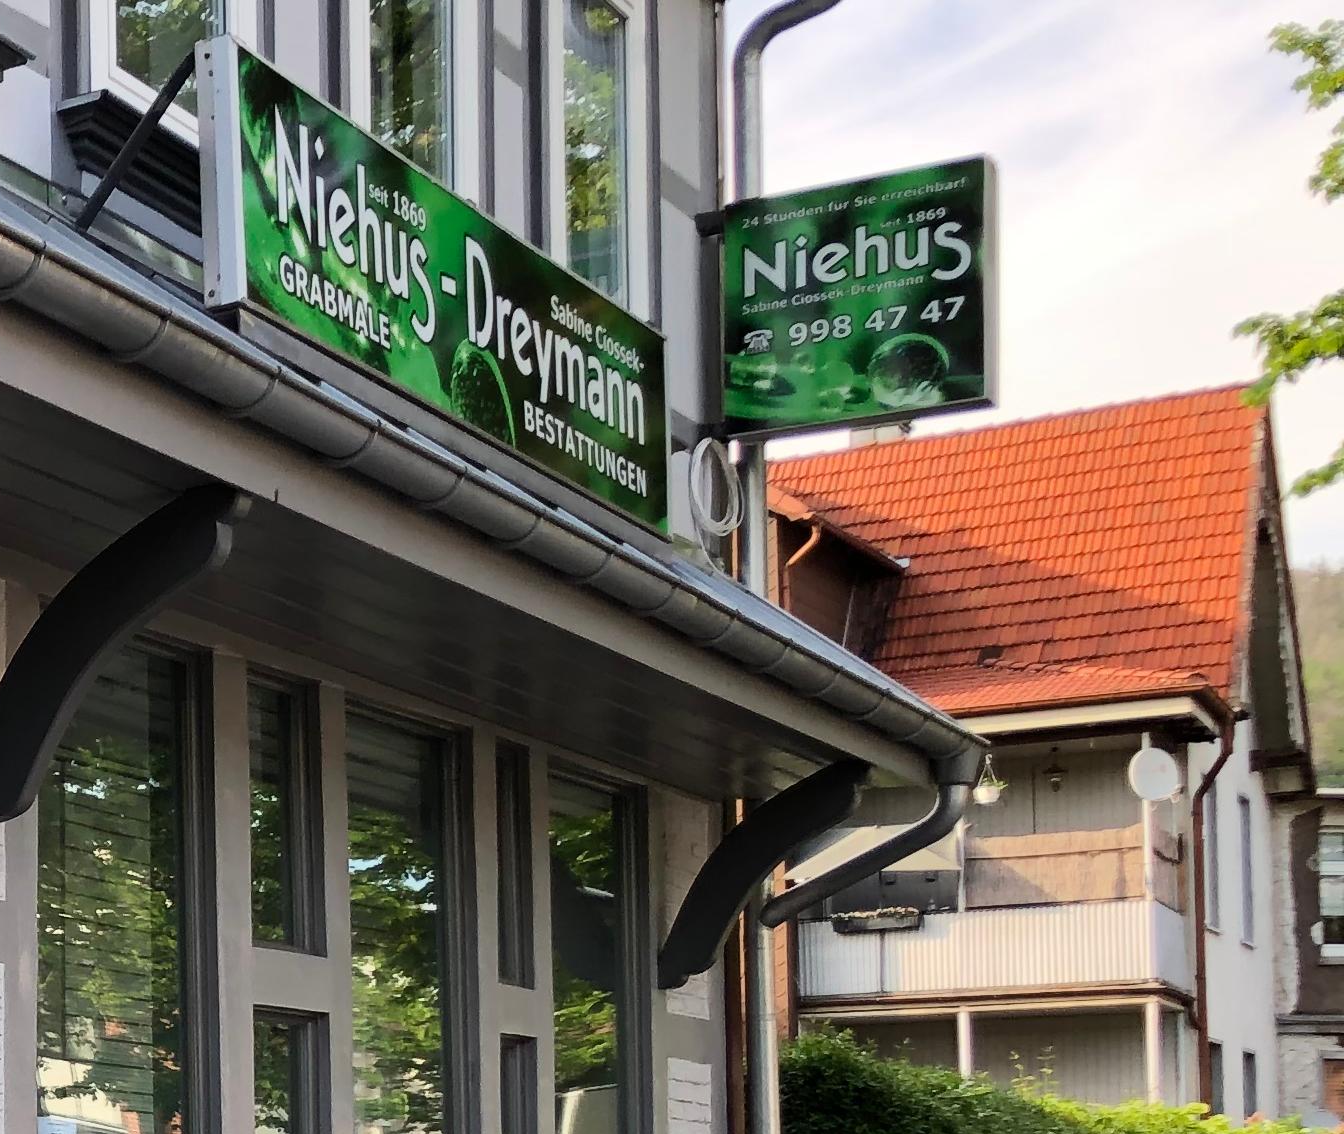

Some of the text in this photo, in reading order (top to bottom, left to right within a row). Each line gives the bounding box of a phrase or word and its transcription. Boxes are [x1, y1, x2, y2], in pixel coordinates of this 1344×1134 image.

[368, 181, 428, 233] seit 1869
[742, 216, 760, 230] 24
[763, 206, 824, 225] Stunden
[853, 194, 877, 208] Sie
[906, 206, 947, 224] 1869
[743, 221, 972, 298] Niehus
[279, 255, 391, 351] GRABMALE
[741, 275, 925, 316] Sabine Ciossek-Dreymann
[788, 296, 966, 347] 998 47 47
[550, 294, 645, 374] Sabine Ciossek-
[524, 400, 648, 498] BESTATTUNGEN
